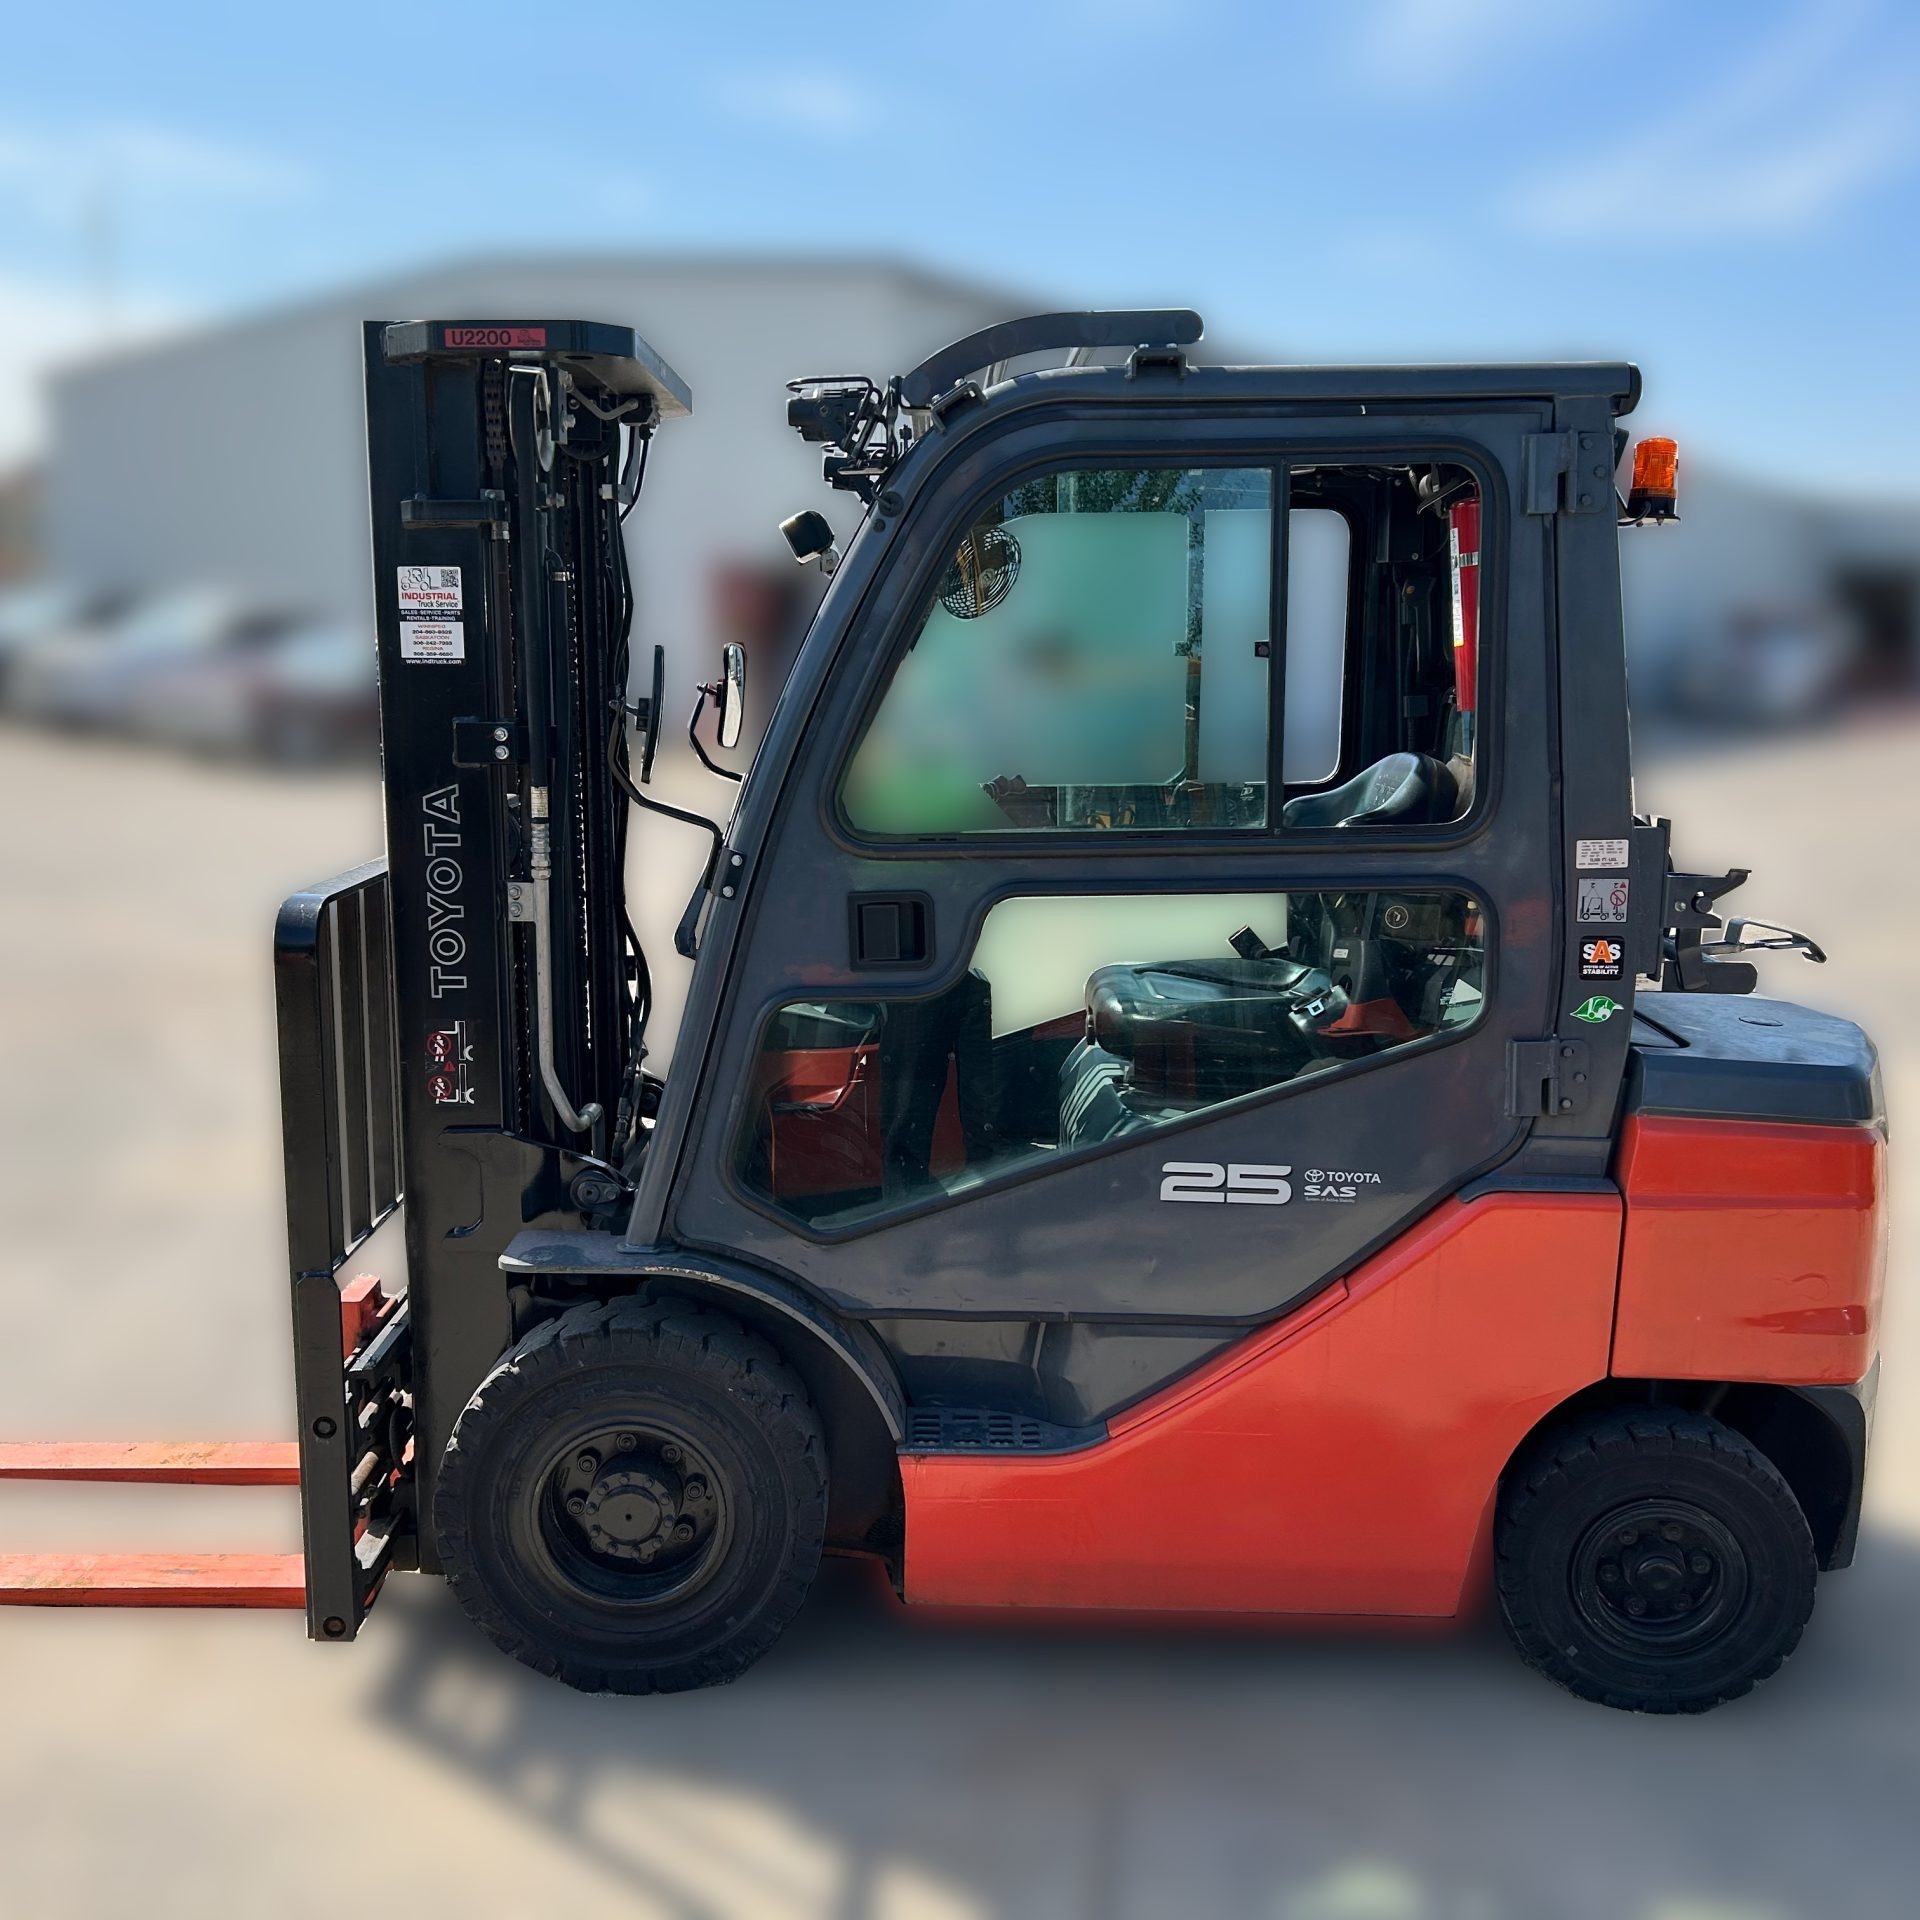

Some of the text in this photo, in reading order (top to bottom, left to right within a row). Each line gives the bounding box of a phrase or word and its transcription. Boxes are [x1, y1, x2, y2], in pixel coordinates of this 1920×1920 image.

[451, 329, 512, 346] U2200
[417, 600, 458, 608] Truck Service
[423, 783, 467, 998] TOYOTA
[1583, 940, 1621, 963] SAS
[1160, 1161, 1292, 1205] 25
[1326, 1171, 1382, 1184] TOYOTA
[1304, 1184, 1357, 1198] SAS
